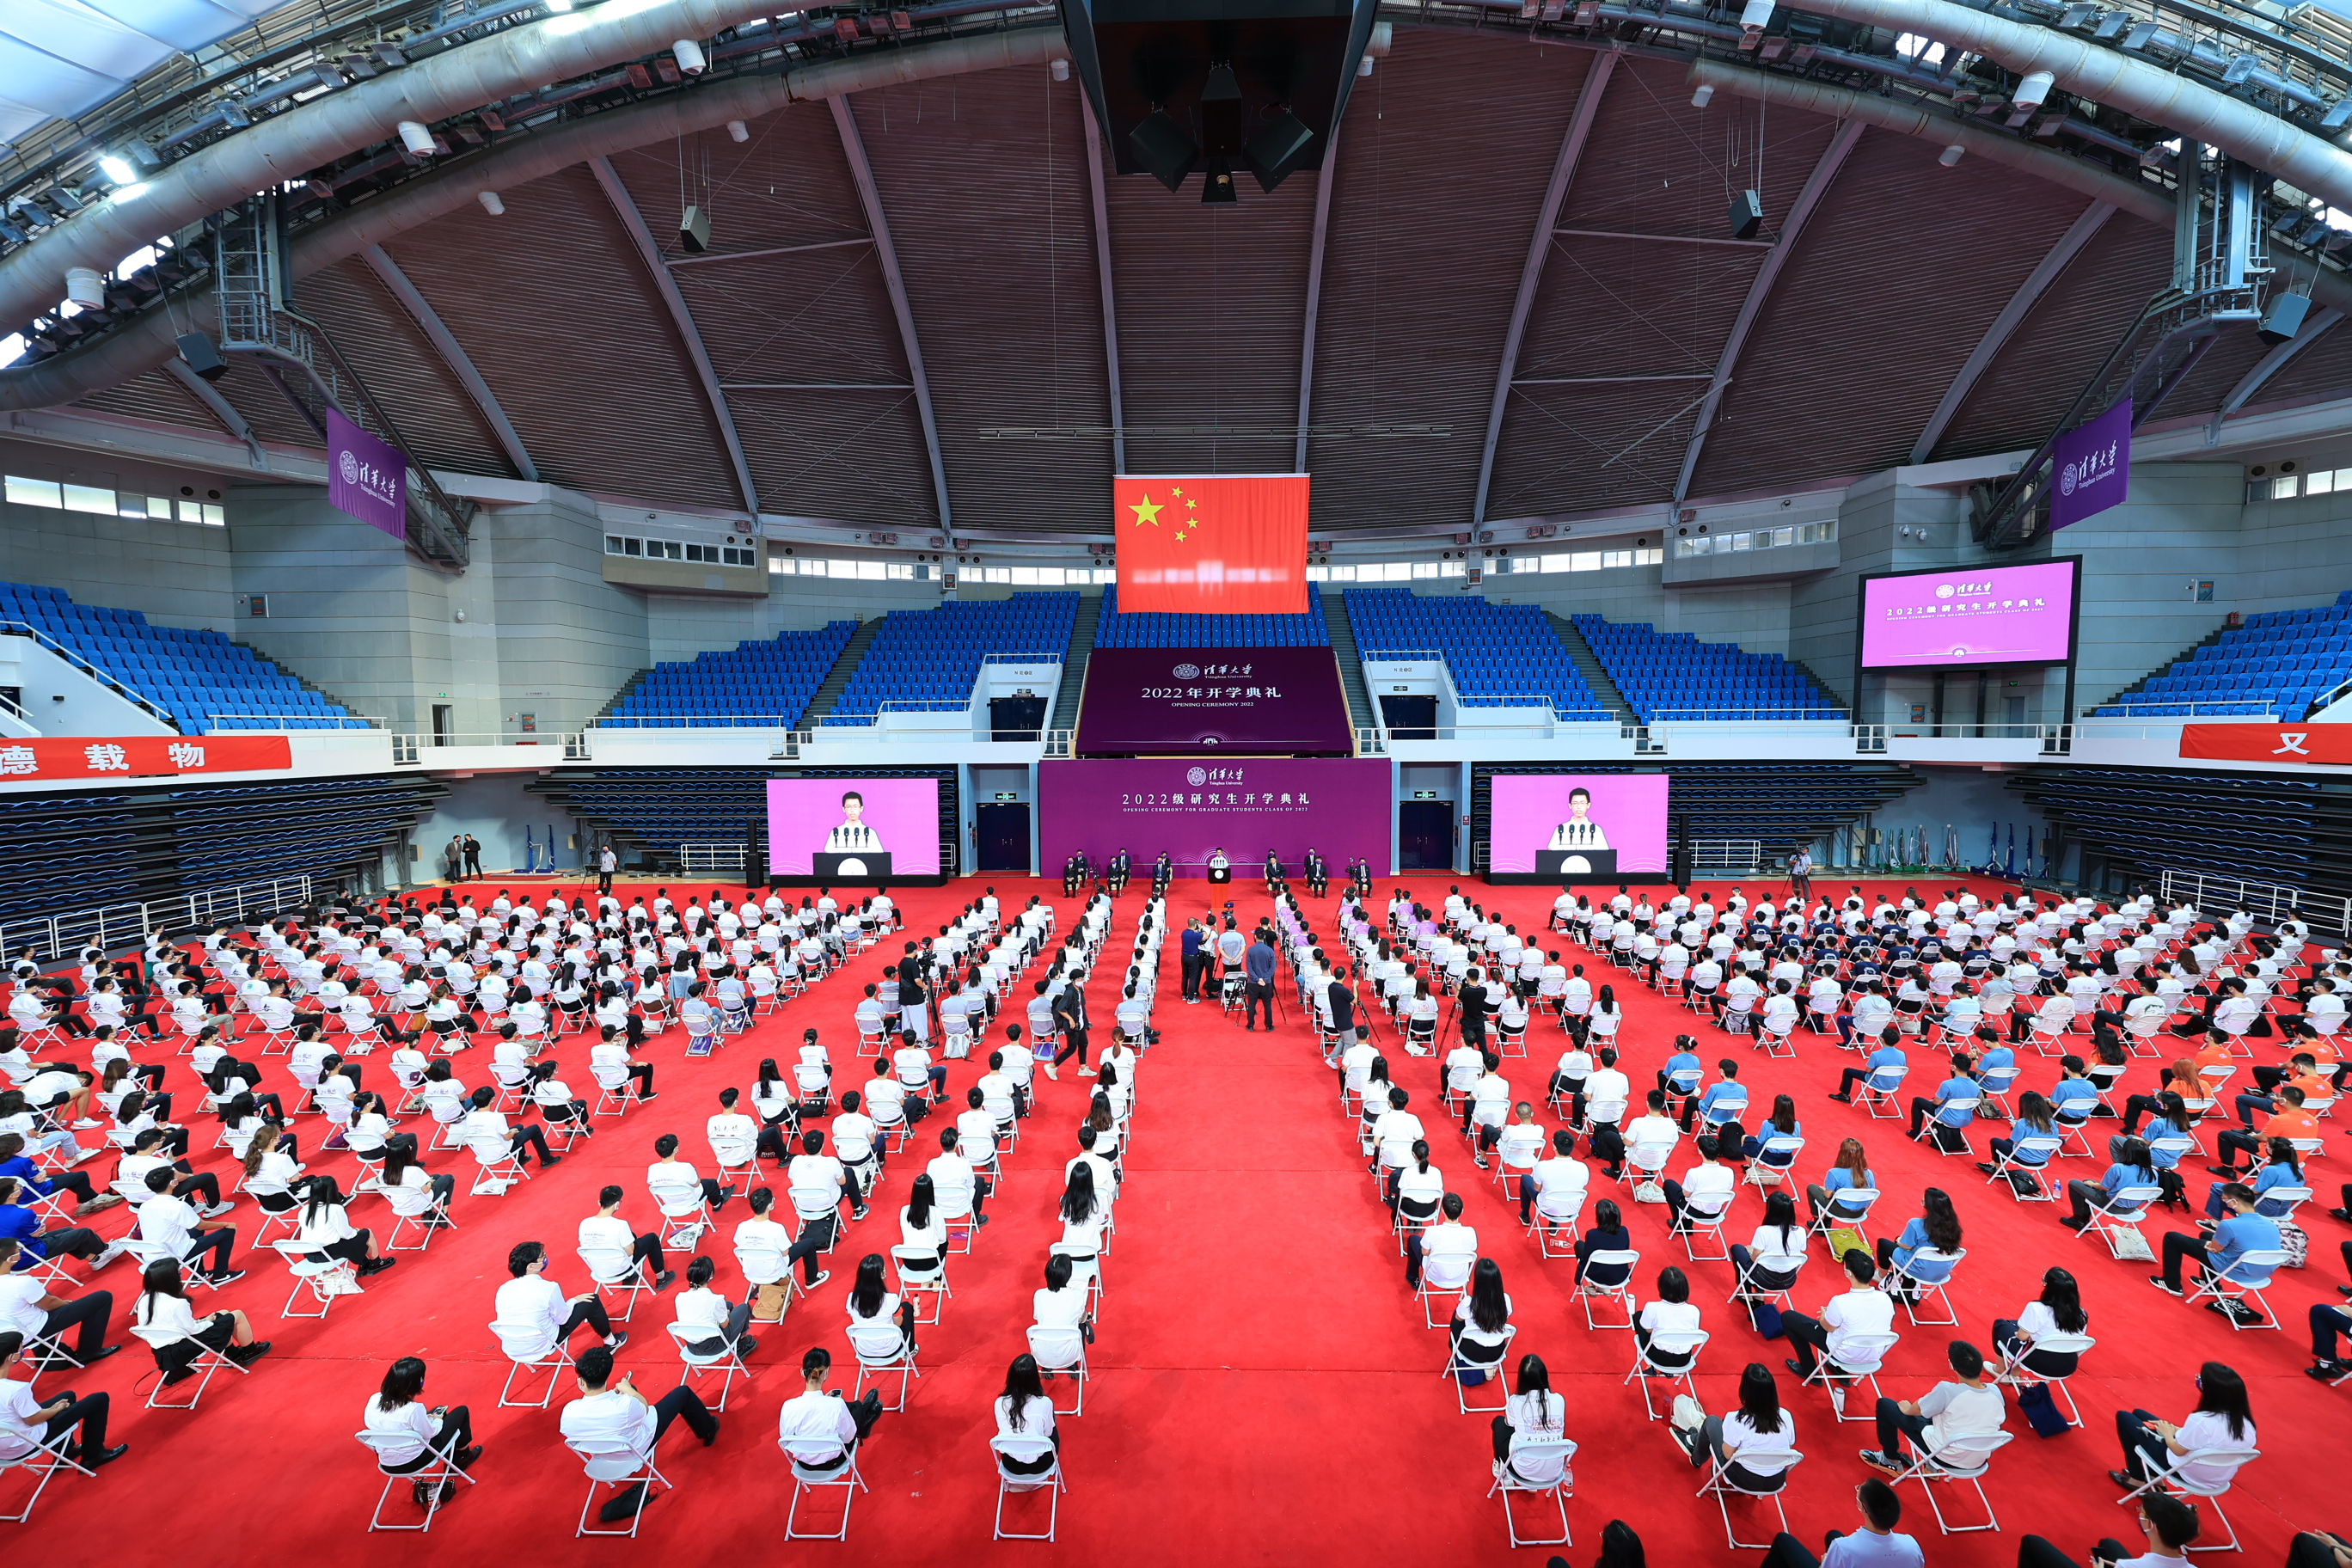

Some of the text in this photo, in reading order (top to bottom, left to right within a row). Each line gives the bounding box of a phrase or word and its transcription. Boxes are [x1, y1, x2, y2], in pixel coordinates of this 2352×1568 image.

[2079, 439, 2117, 481] 清华大学
[359, 462, 396, 499] 清华大学
[2079, 467, 2116, 489] Tsinghua University
[360, 483, 395, 508] Tsinghua University
[1886, 597, 2045, 616] 2022级研究生开学典礼
[1204, 663, 1253, 675] 清华大学
[1141, 687, 1282, 698] 2022年开学典礼
[1209, 767, 1244, 781] 清华大学
[1122, 793, 1310, 805] 2022级研究生开学典礼
